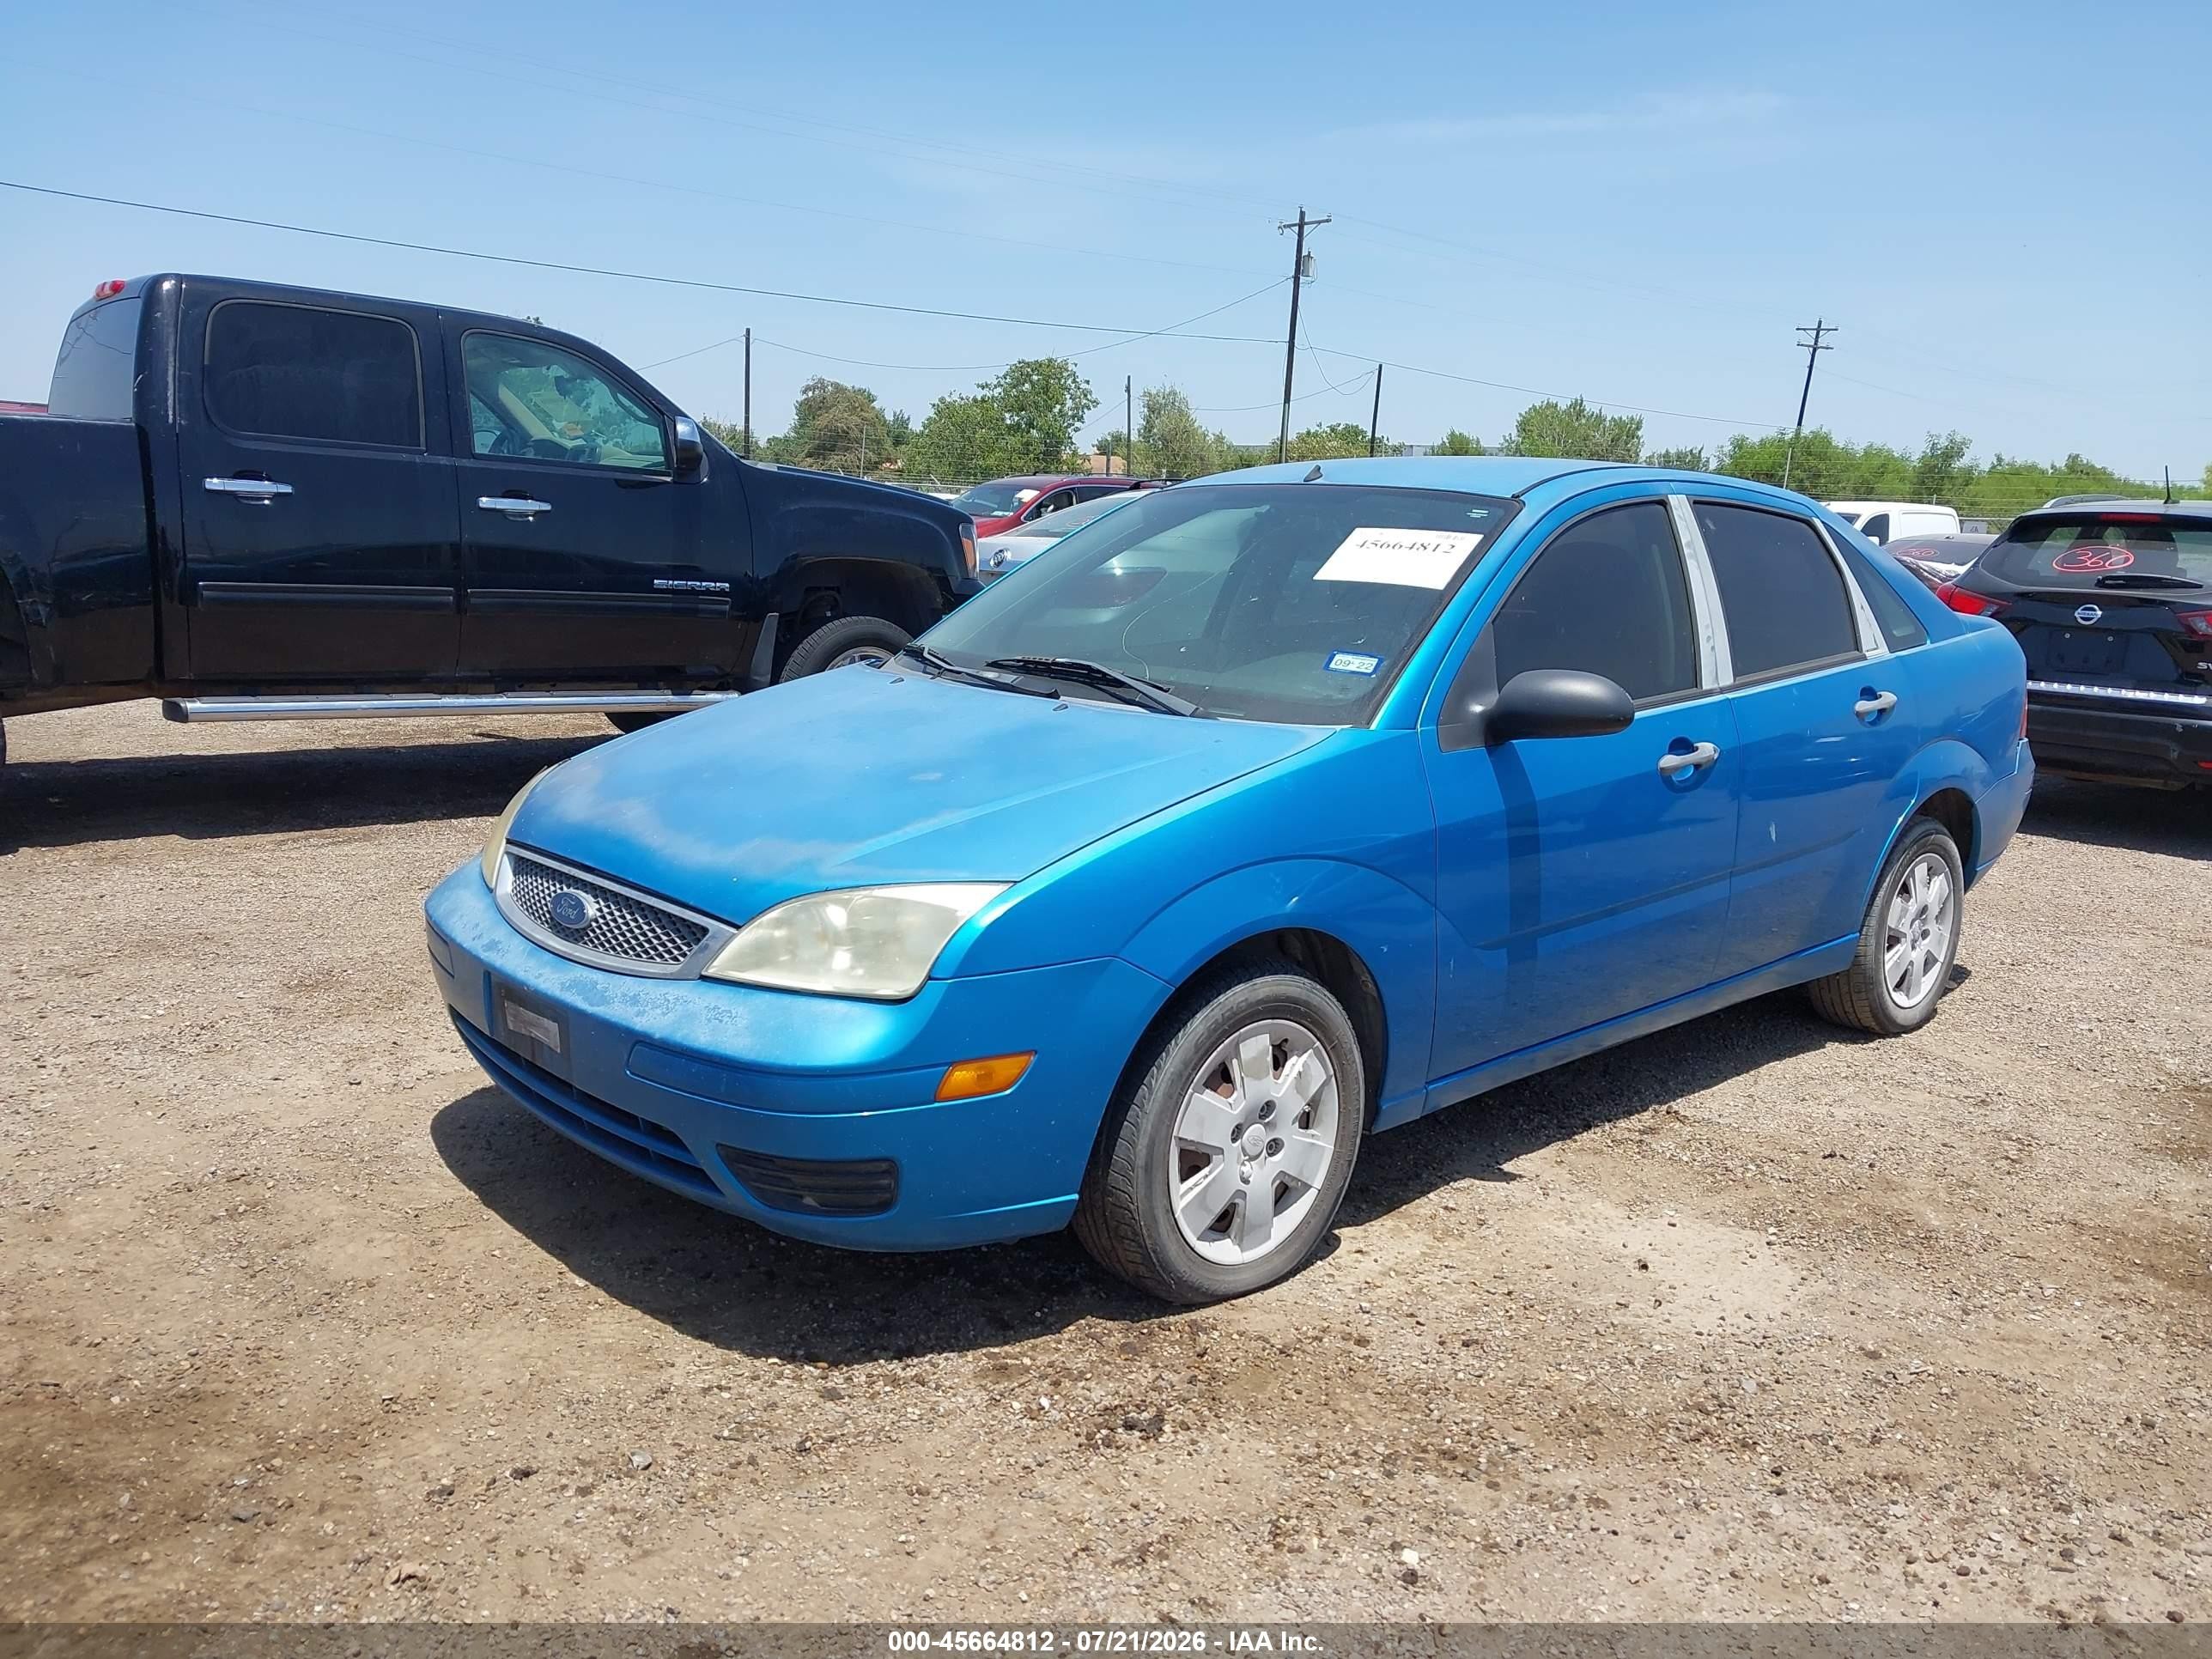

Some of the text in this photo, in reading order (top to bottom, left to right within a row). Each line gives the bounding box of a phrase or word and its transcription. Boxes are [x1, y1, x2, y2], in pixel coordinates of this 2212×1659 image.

[2063, 550, 2135, 568] 360
[653, 579, 730, 592] SIERRA
[556, 897, 580, 919] Ford
